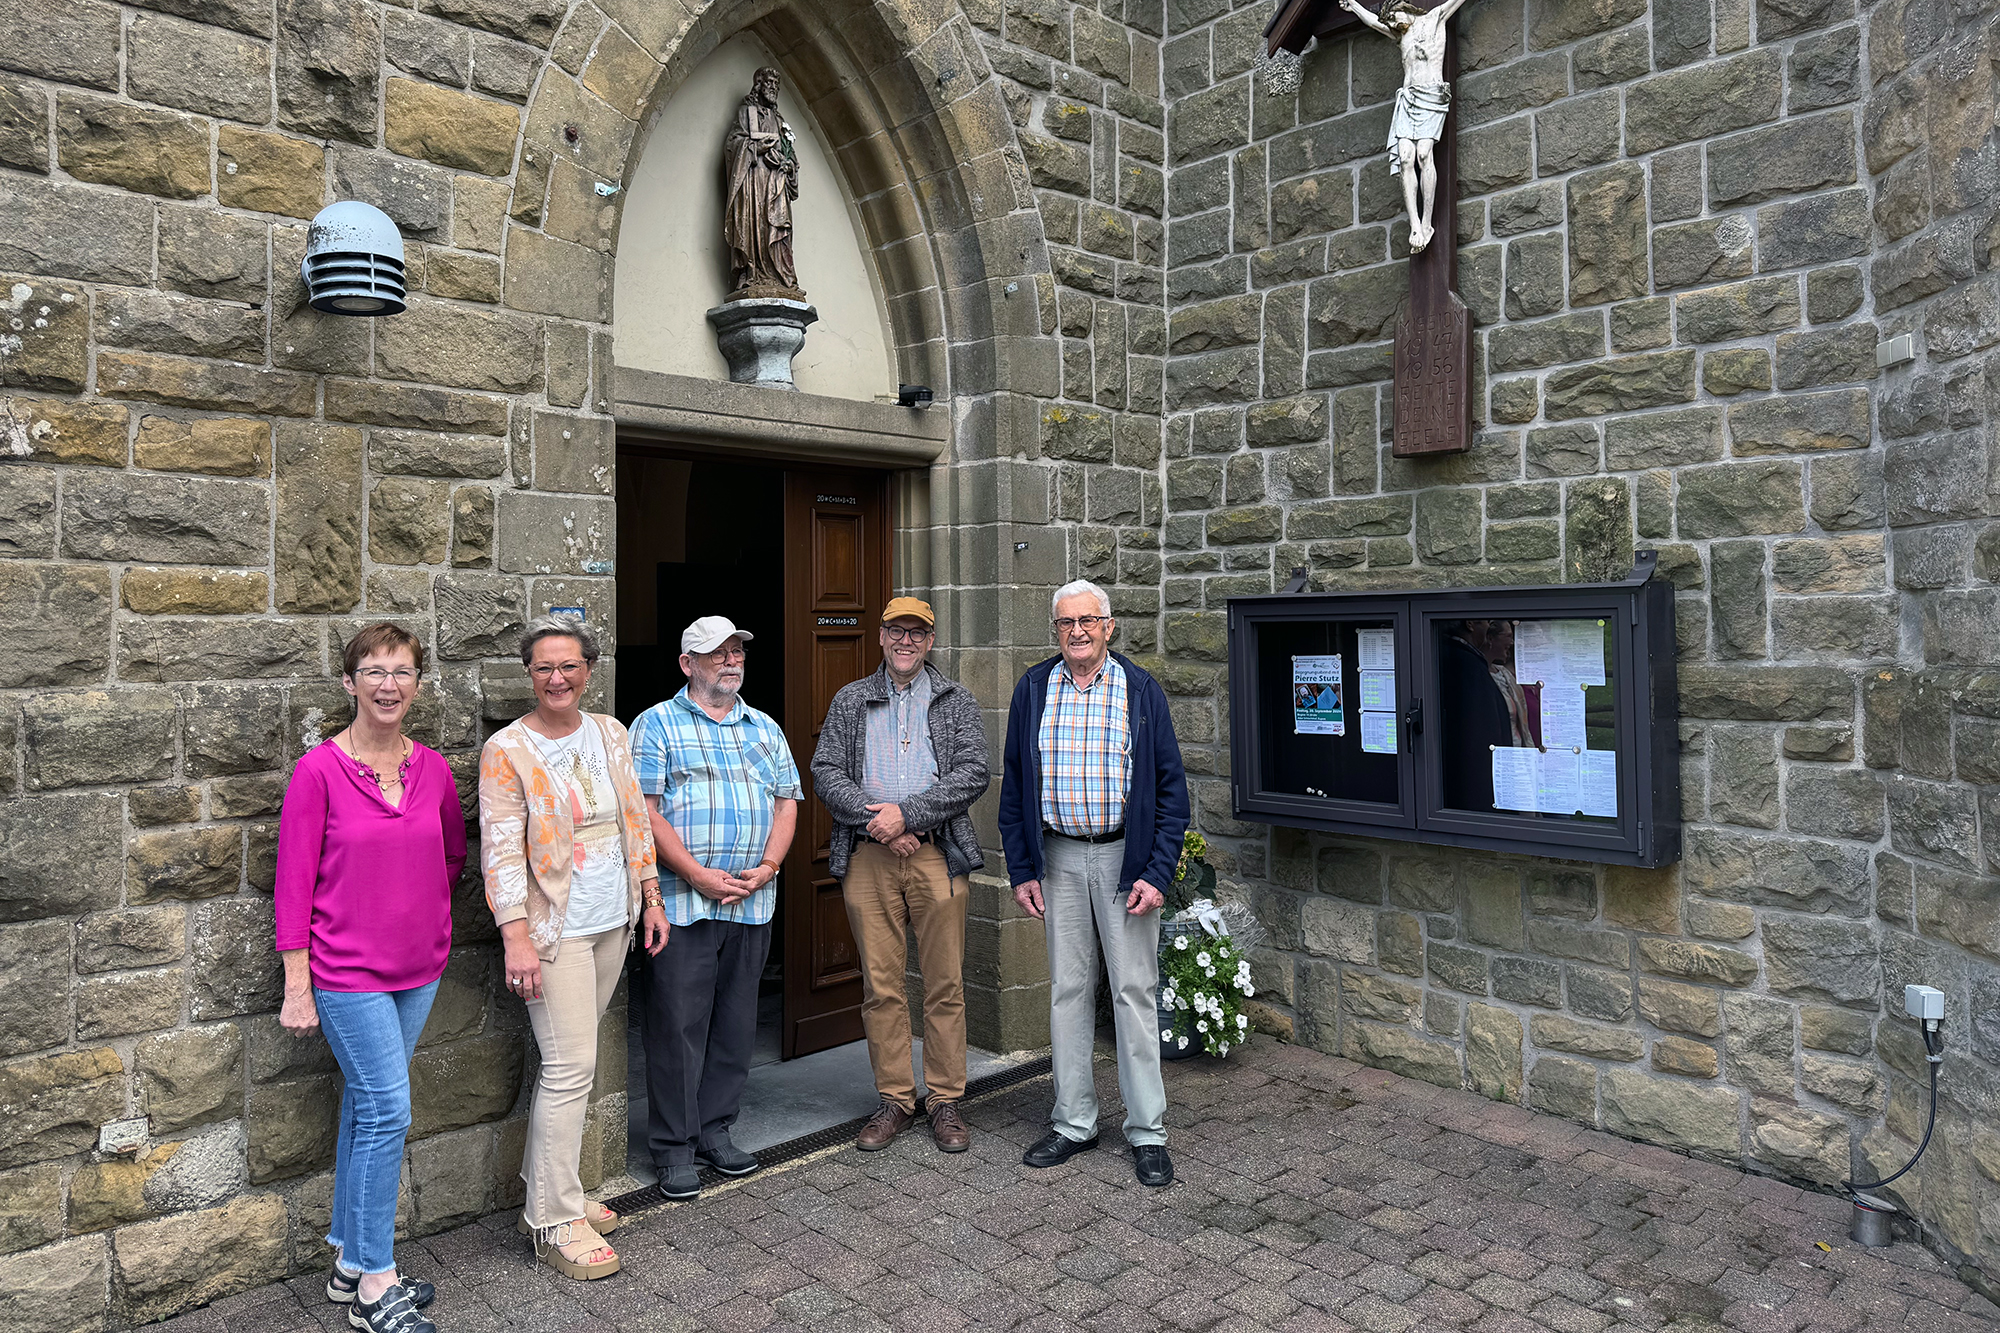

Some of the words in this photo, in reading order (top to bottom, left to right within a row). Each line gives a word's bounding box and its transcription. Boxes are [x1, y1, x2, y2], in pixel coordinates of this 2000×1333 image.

[1399, 310, 1463, 337] MISSION
[1403, 338, 1422, 357] 19
[1433, 332, 1453, 352] 47
[1403, 361, 1422, 381] 19
[1431, 356, 1453, 376] 56
[1400, 380, 1456, 402] RETTE
[1400, 403, 1455, 425] DEINE
[1400, 426, 1456, 447] SEELE
[1295, 674, 1317, 682] Pierre
